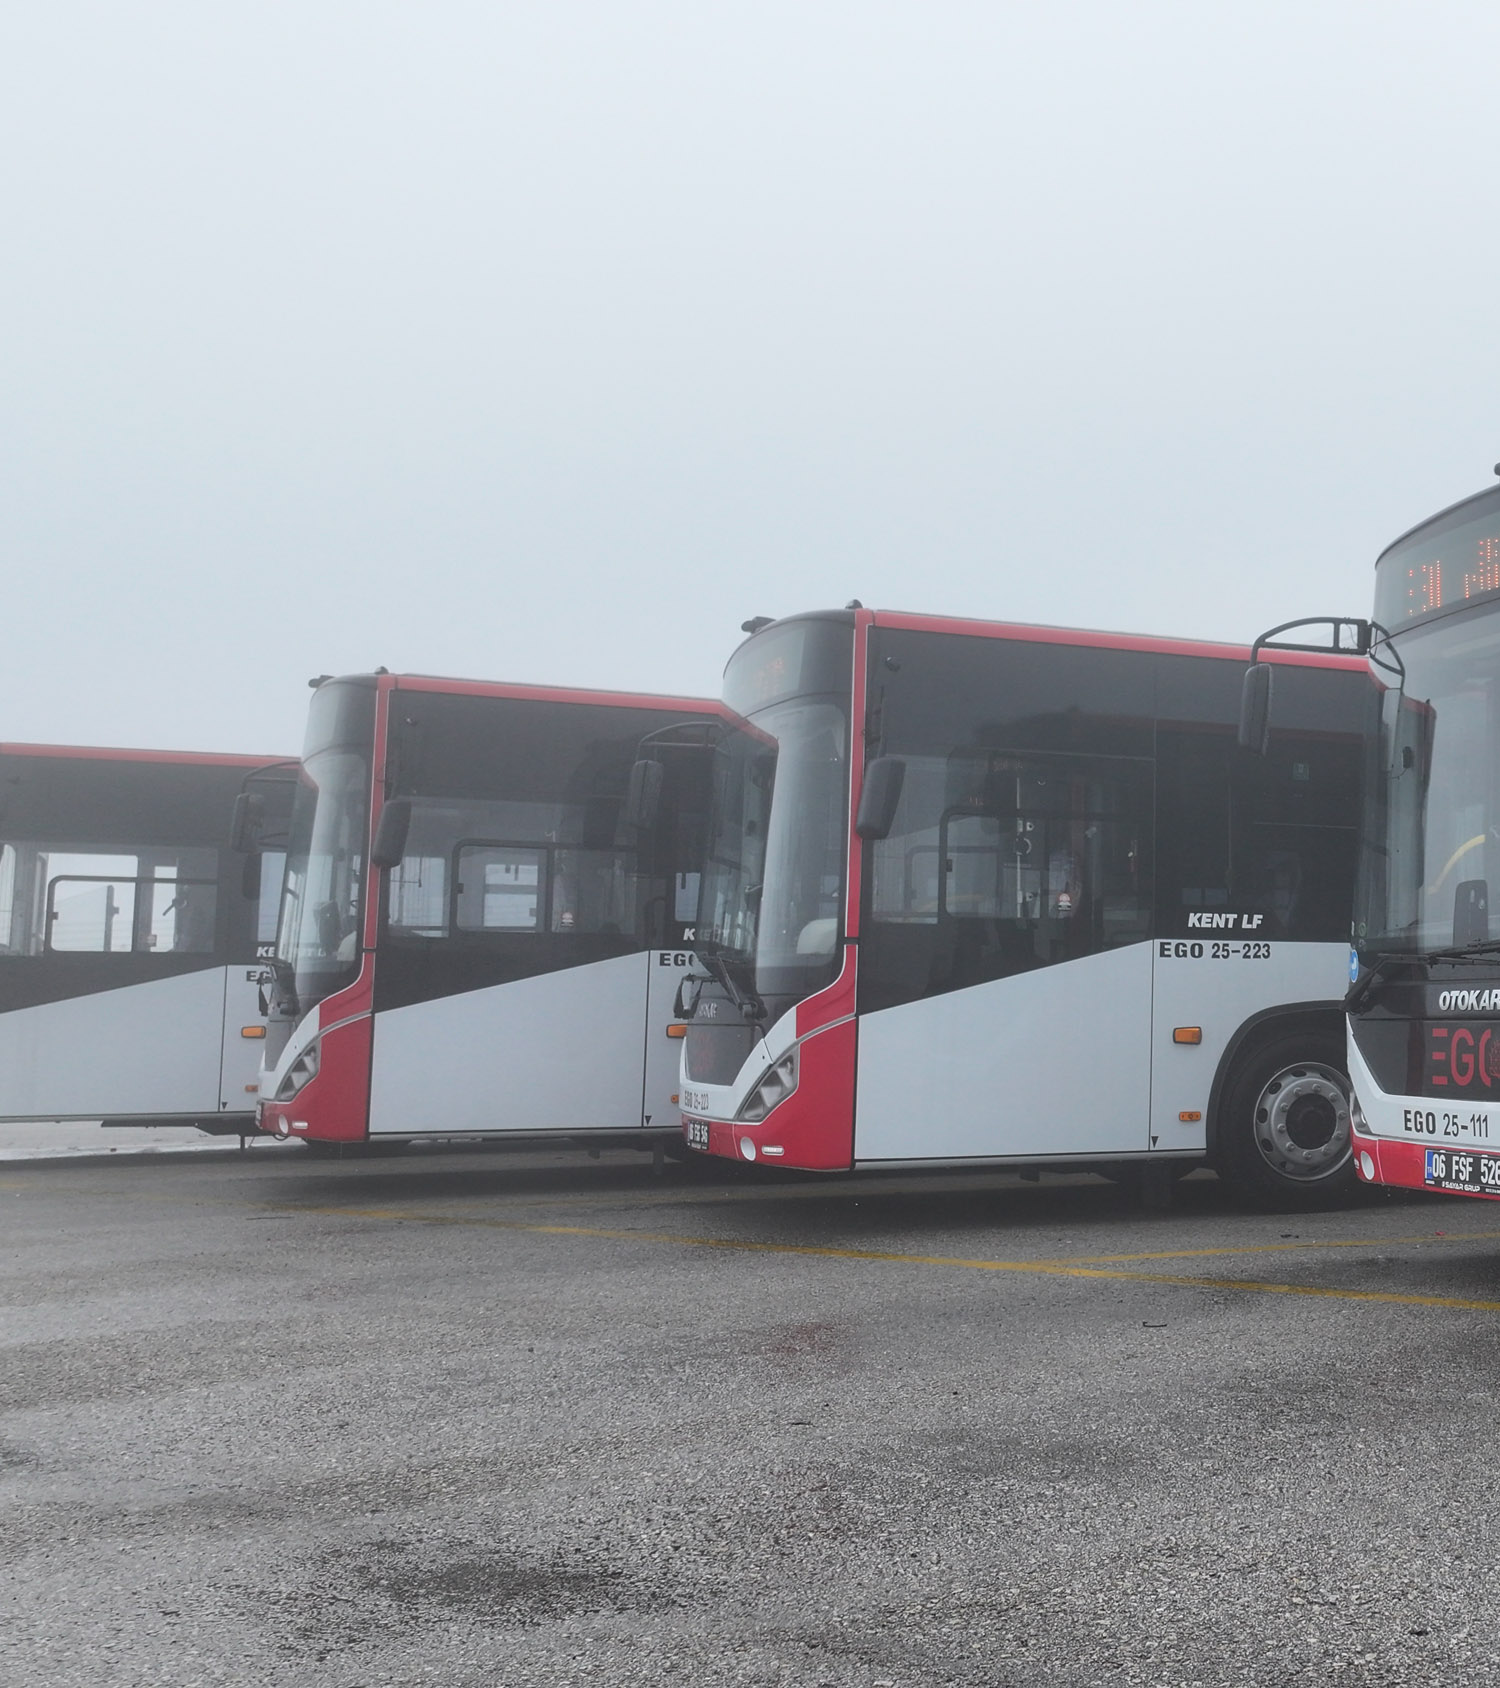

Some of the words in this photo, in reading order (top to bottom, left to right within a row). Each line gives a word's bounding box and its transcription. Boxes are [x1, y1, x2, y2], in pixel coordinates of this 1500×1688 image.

[1187, 912, 1238, 928] KENT
[1241, 914, 1263, 929] LF
[1159, 942, 1204, 958] EGO
[1211, 943, 1271, 959] 25-223
[1403, 1109, 1437, 1134] EGO
[1443, 1113, 1488, 1138] 25-111
[1432, 1153, 1446, 1178] 06
[1452, 1156, 1473, 1181] FSF
